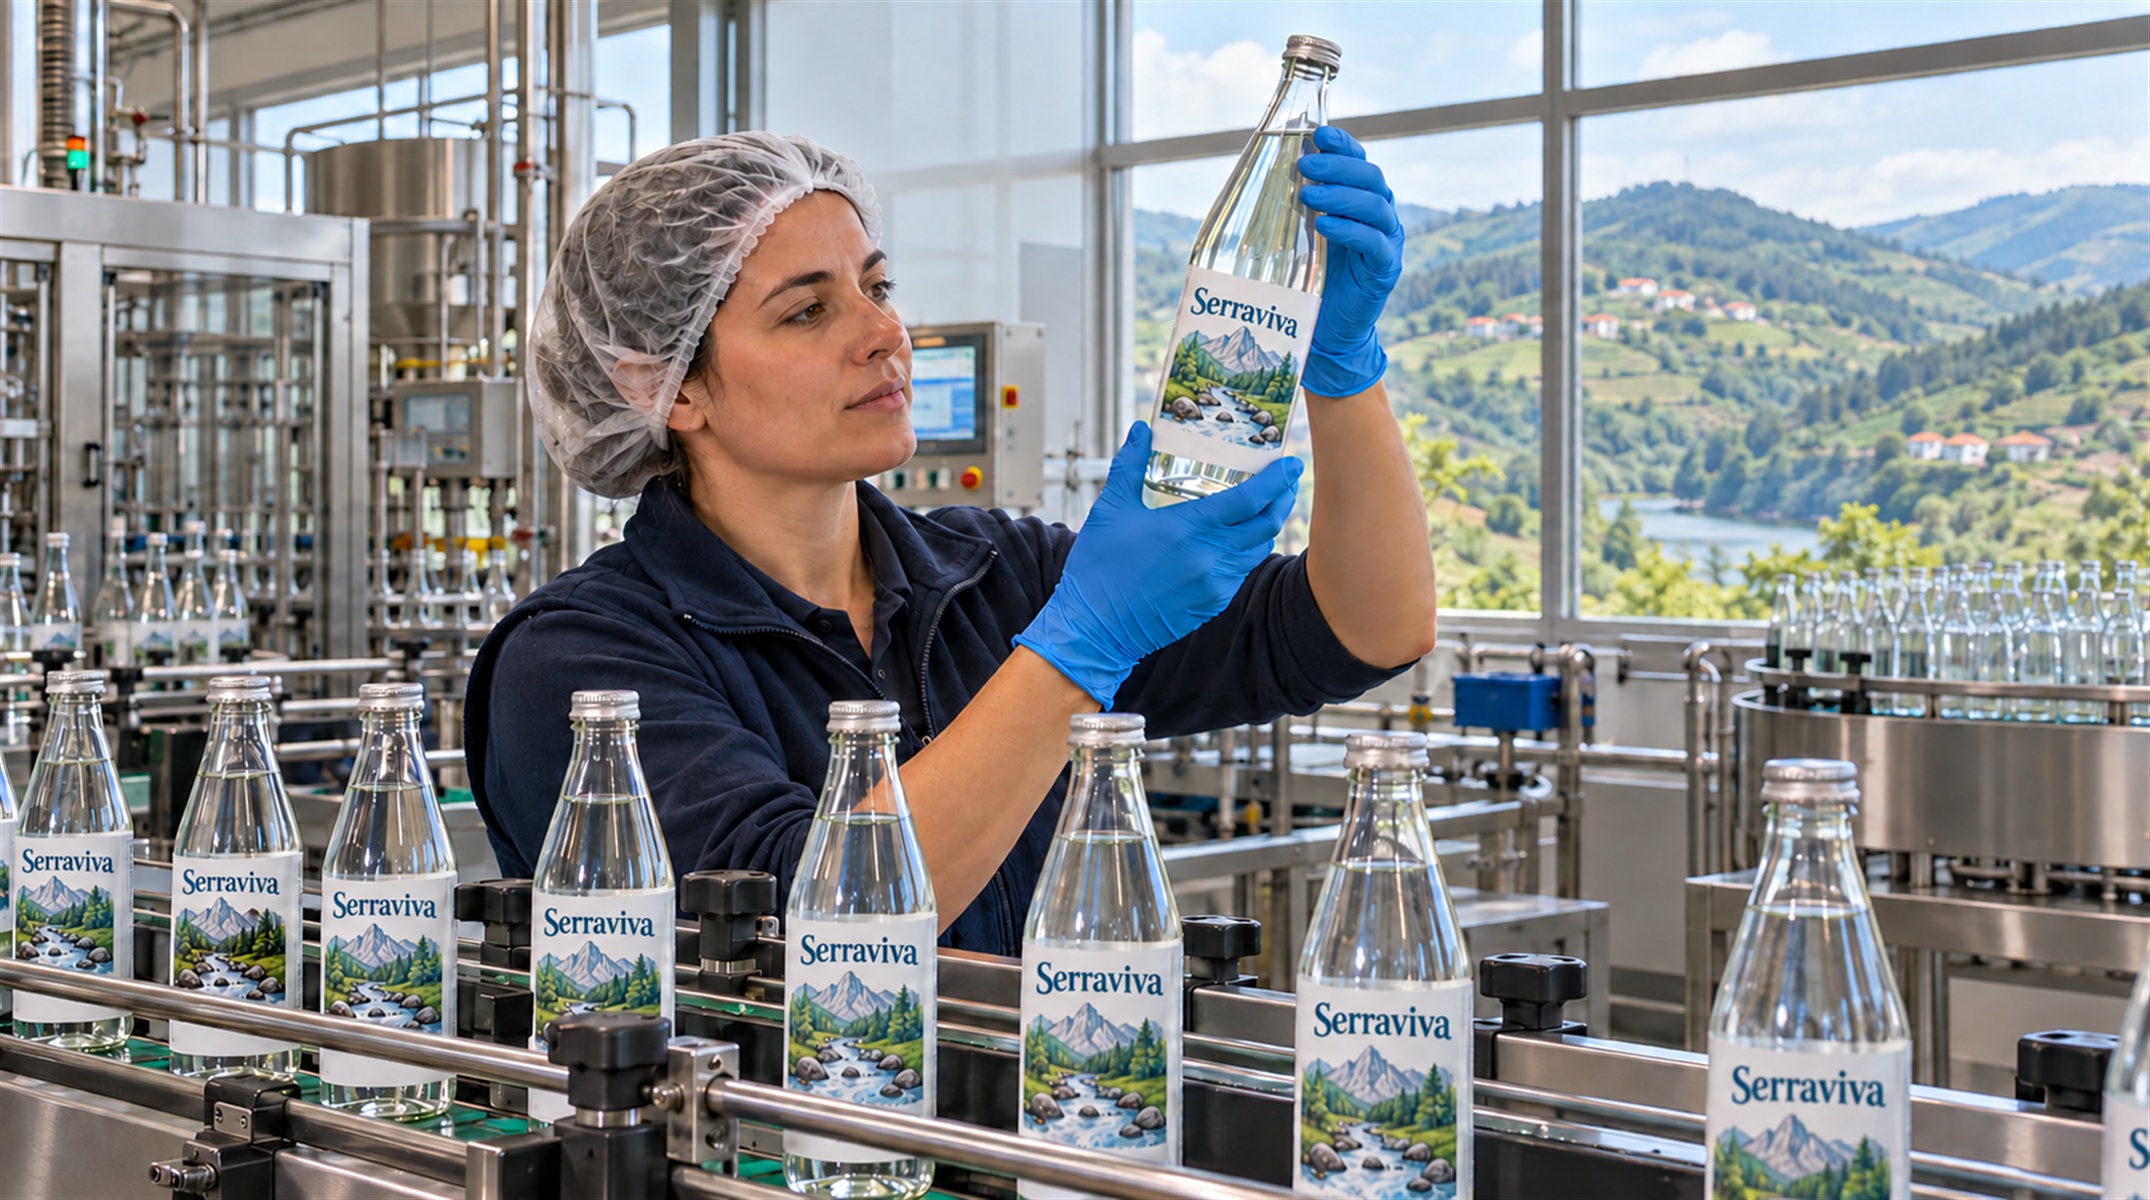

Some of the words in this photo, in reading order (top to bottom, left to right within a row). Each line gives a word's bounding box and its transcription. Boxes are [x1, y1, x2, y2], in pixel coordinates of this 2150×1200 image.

[1190, 286, 1298, 339] Serraviva
[22, 848, 115, 874] Serraviva
[182, 868, 280, 896] Serraviva
[332, 891, 438, 919] Serraviva
[543, 907, 656, 938] Serraviva
[800, 934, 919, 966] Serraviva
[1035, 961, 1164, 997] Serraviva
[1313, 1001, 1453, 1041] Serraviva
[1731, 1065, 1887, 1108] Serraviva
[2128, 1127, 2150, 1171] S
